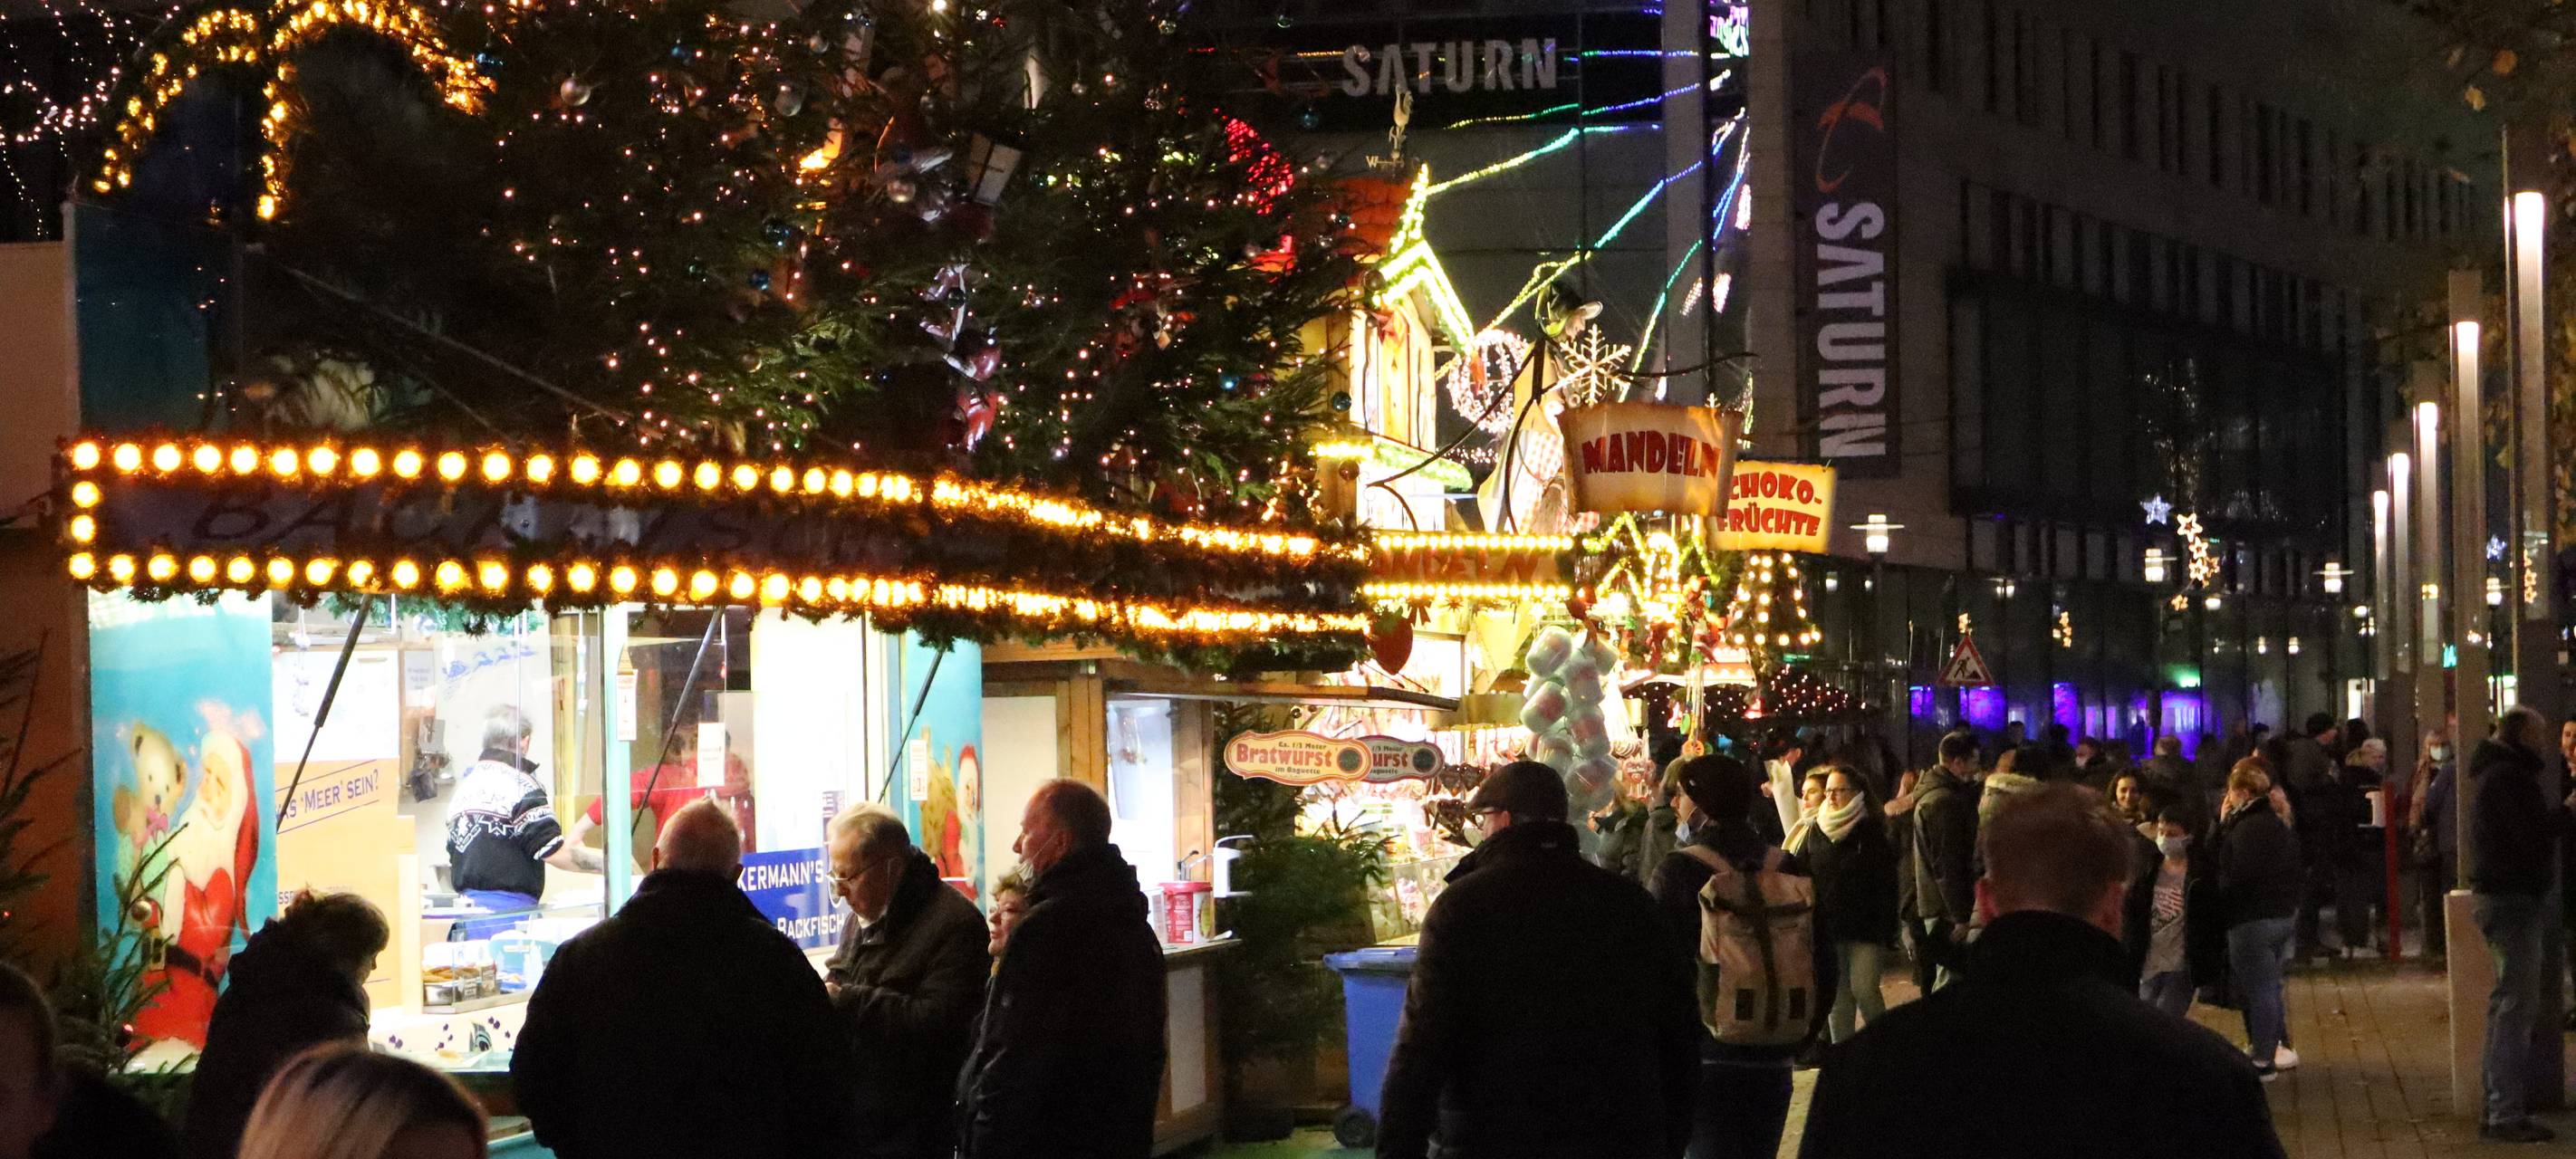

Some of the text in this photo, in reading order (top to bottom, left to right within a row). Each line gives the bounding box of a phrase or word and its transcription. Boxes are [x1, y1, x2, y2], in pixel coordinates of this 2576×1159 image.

[1341, 38, 1556, 96] SATURN
[1816, 202, 1886, 457] SATURN
[1581, 430, 1721, 477] MANDELN
[1236, 743, 1331, 767] Bratwurst
[348, 769, 379, 799] SEIN?
[777, 913, 844, 940] BACKFISCH
